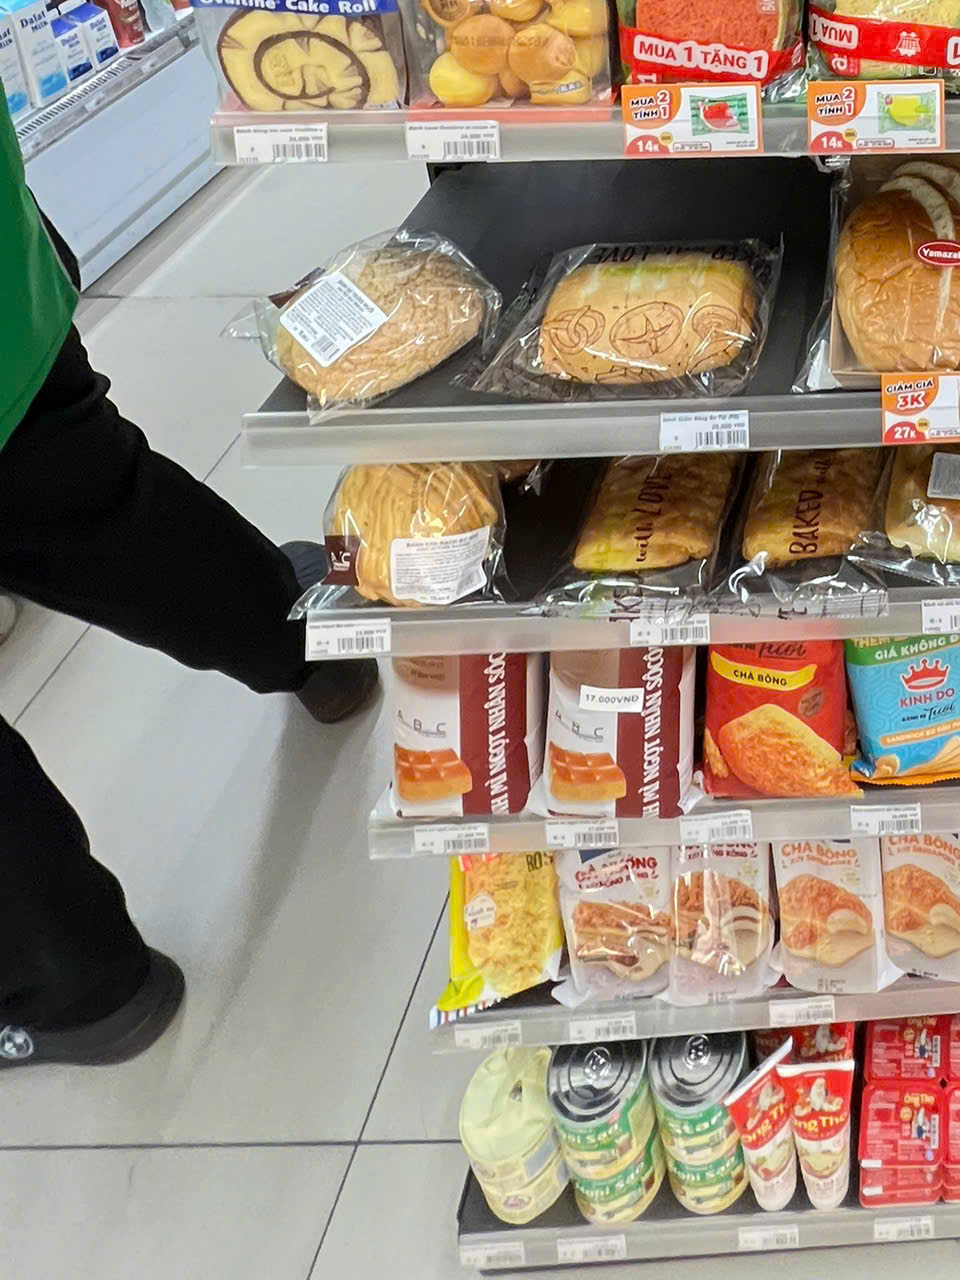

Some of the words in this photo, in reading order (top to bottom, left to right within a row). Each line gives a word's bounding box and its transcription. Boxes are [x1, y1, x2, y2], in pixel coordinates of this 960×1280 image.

[338, 0, 377, 13] Roll
[638, 39, 676, 61] MUA
[683, 45, 694, 62] 1
[700, 48, 747, 72] TẶNG
[754, 56, 765, 73] 1
[631, 98, 655, 107] MUA
[657, 91, 669, 103] 2
[816, 94, 840, 103] MUA
[843, 88, 853, 100] 2
[633, 108, 658, 119] TÍNH
[661, 106, 668, 118] 1
[818, 105, 843, 116] TÍNH
[845, 103, 853, 114] 1
[886, 383, 913, 393] GIẢM
[915, 378, 933, 388] GIÁ
[898, 393, 925, 408] 3K
[894, 426, 916, 439] 27K
[788, 489, 824, 555] BAKED
[874, 645, 898, 660] GIÁ
[901, 636, 946, 656] KHÔNG
[733, 669, 755, 682] CHÀ
[757, 673, 788, 687] BÔNG
[900, 694, 933, 709] KINH
